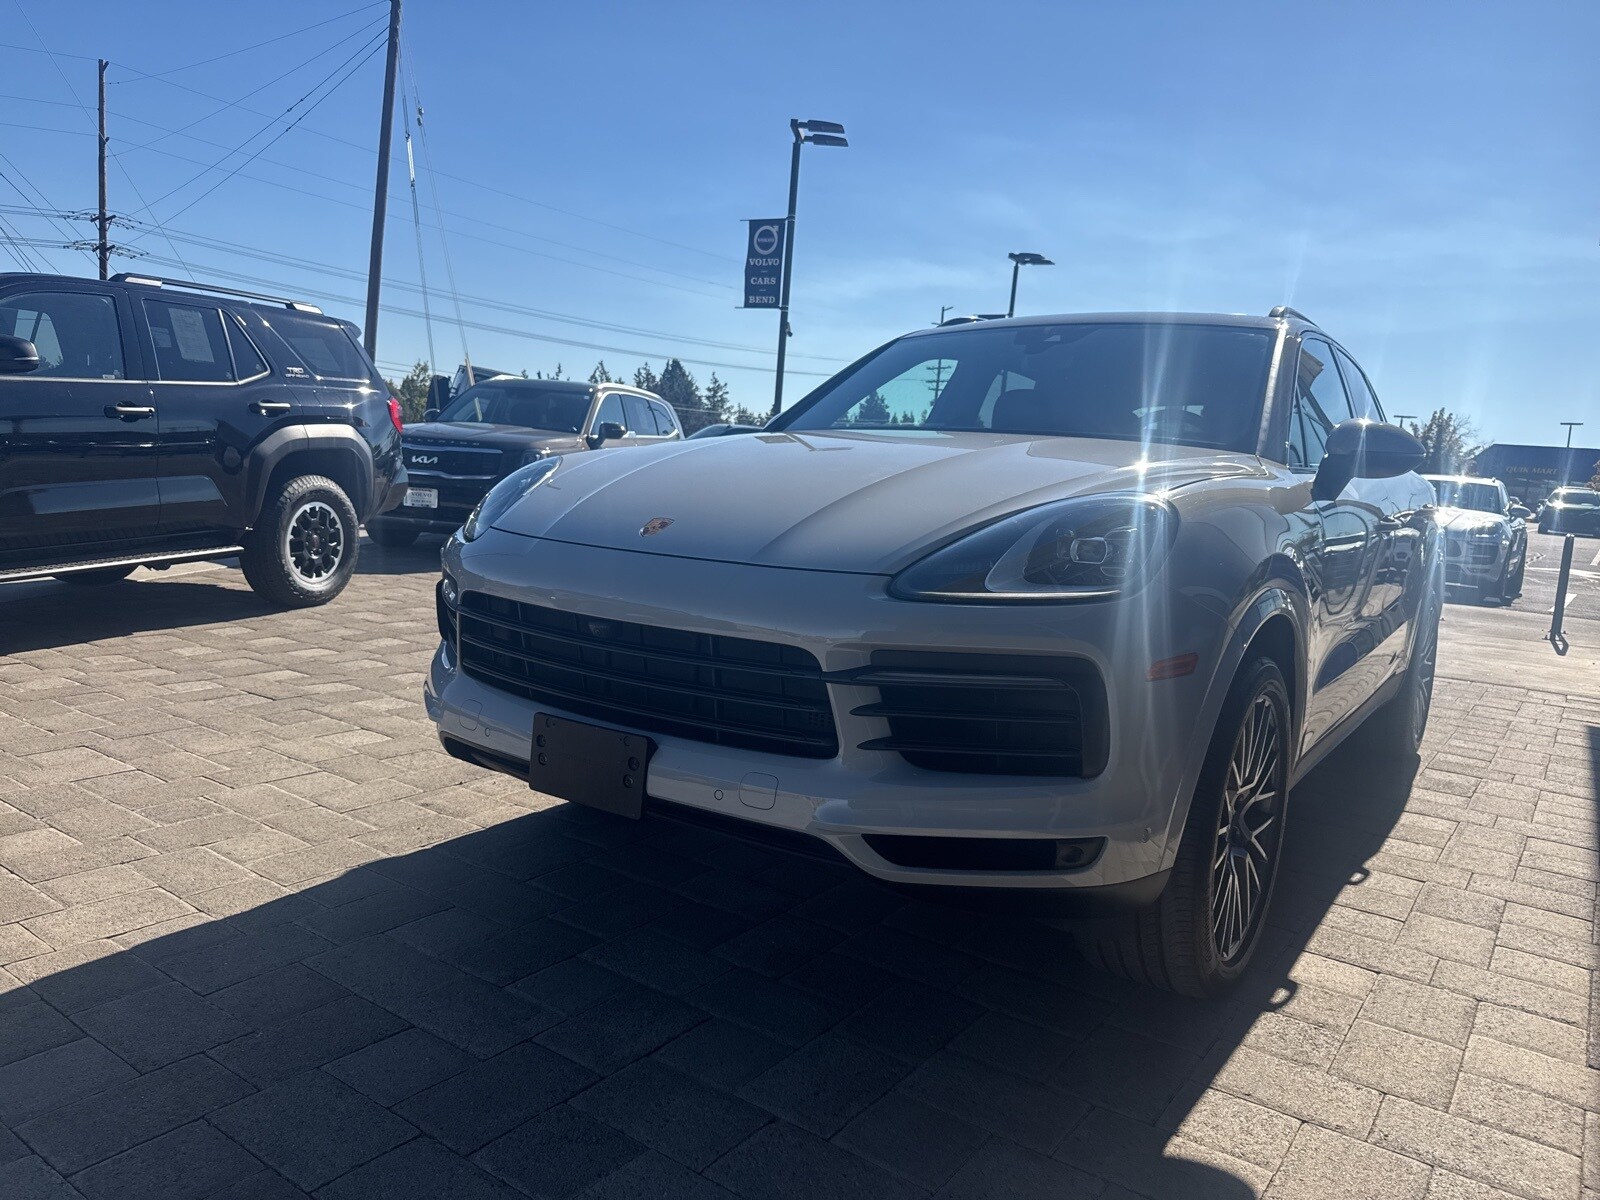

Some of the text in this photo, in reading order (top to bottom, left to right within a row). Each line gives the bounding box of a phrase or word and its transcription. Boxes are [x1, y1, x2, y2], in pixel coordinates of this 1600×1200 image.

[749, 258, 780, 266] VOLVO
[750, 277, 777, 285] CARS
[748, 296, 776, 304] BEND
[286, 366, 305, 374] TRD
[411, 455, 439, 464] KIA
[1505, 465, 1558, 475] QUIK MART
